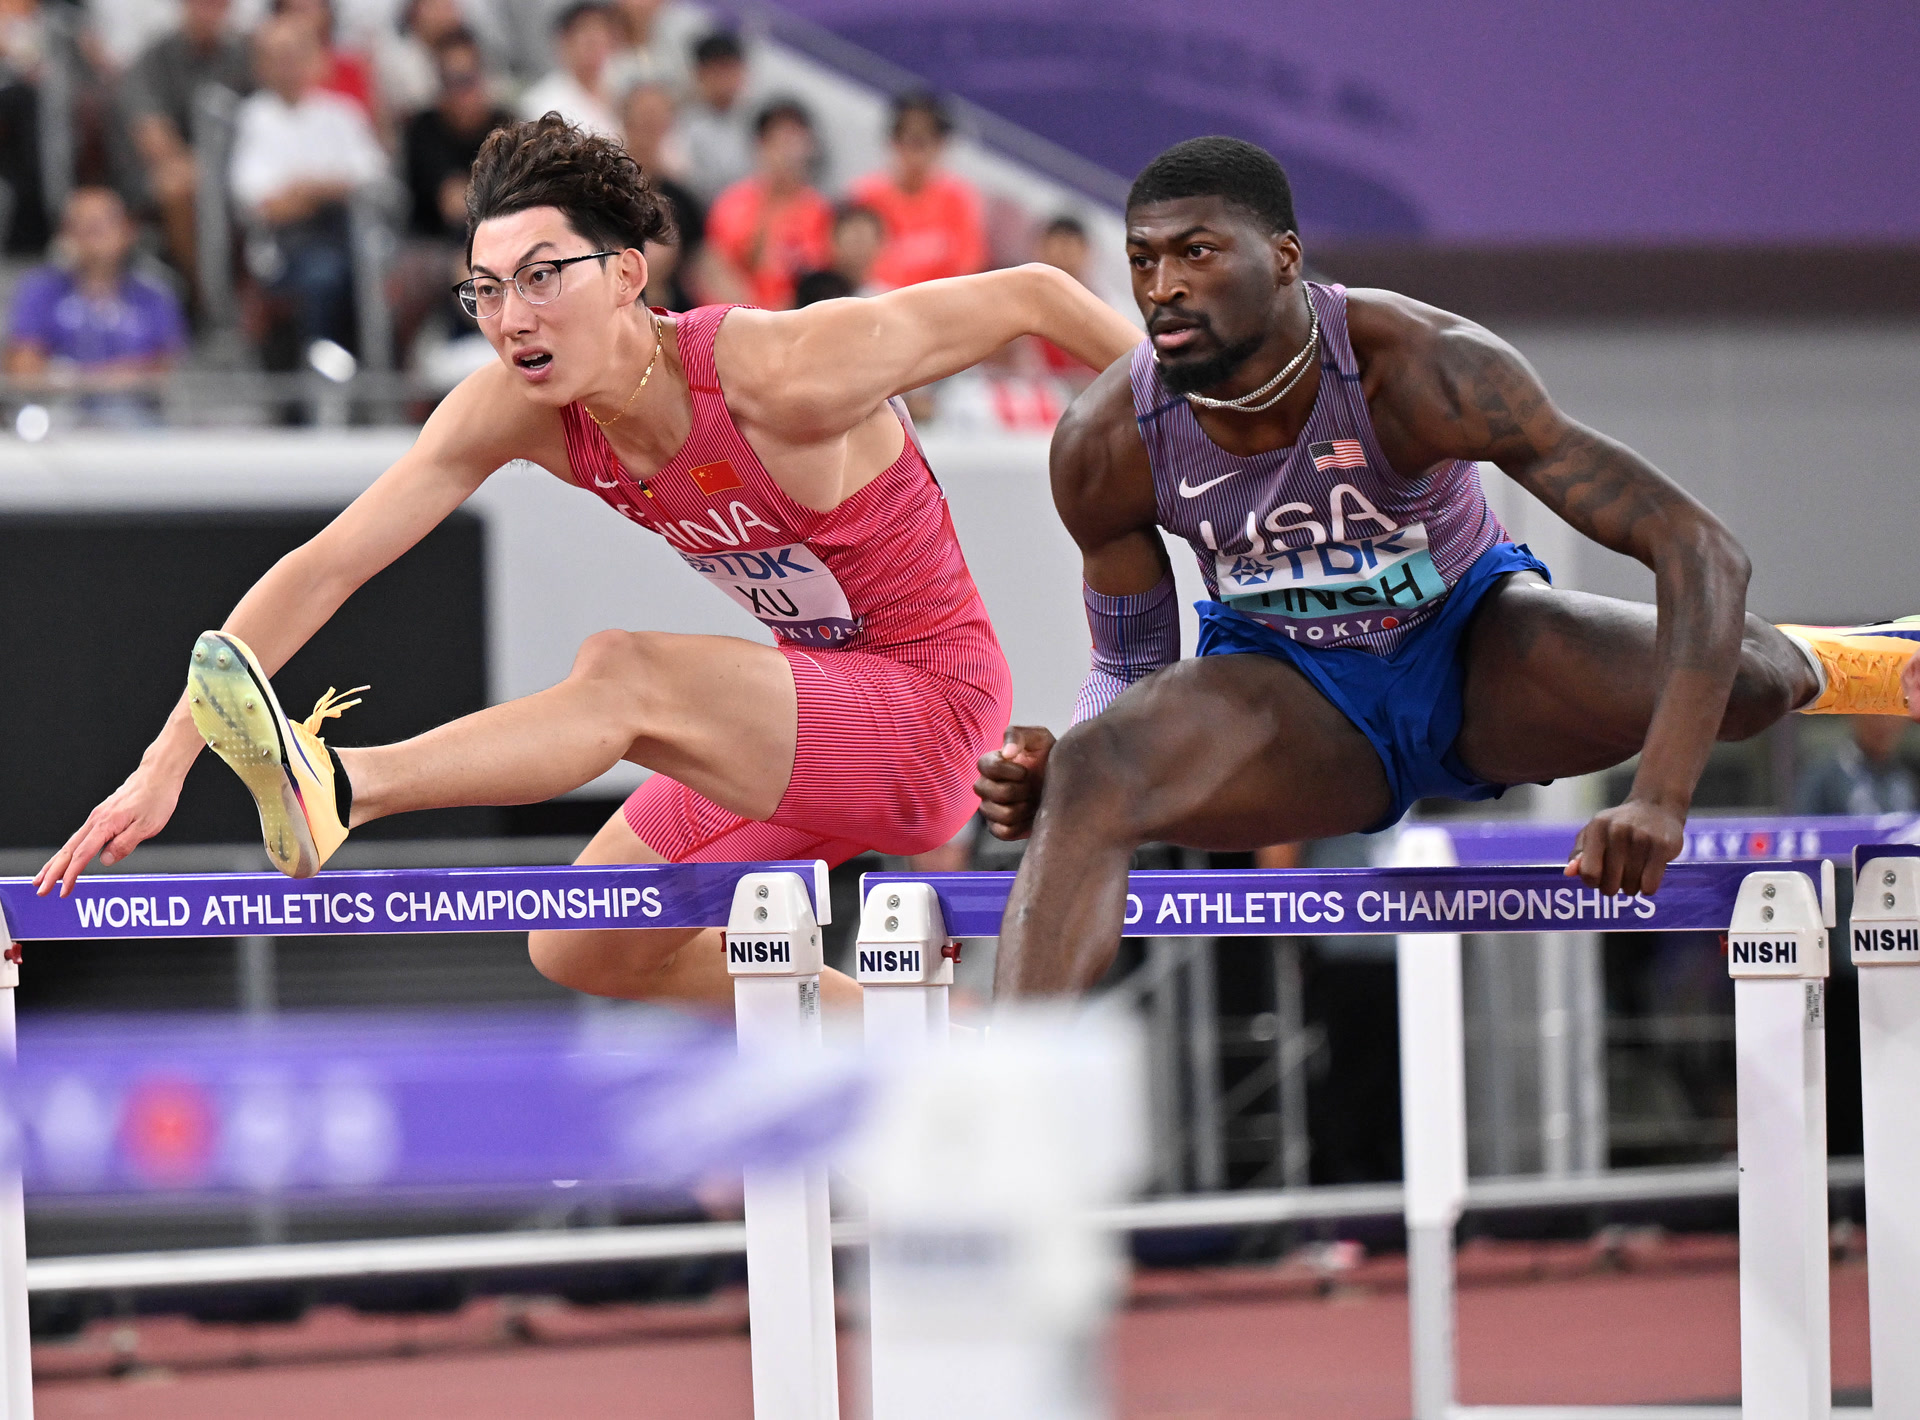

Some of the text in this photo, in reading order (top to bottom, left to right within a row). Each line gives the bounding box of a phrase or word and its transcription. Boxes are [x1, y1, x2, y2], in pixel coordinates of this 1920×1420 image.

[1199, 483, 1398, 555] USA
[697, 547, 815, 580] TDK
[1266, 530, 1412, 580] TDK
[734, 585, 800, 618] XU
[75, 886, 663, 929] WORLD ATHLETICS CHAMPIONSHIPS
[1155, 890, 1345, 925] ATHLETICS
[1356, 887, 1657, 923] CHAMPIONSHIPS
[729, 940, 790, 963] NISHI
[1732, 940, 1797, 964] NISHI
[1853, 928, 1919, 952] NISHI
[859, 949, 920, 973] NISHI
